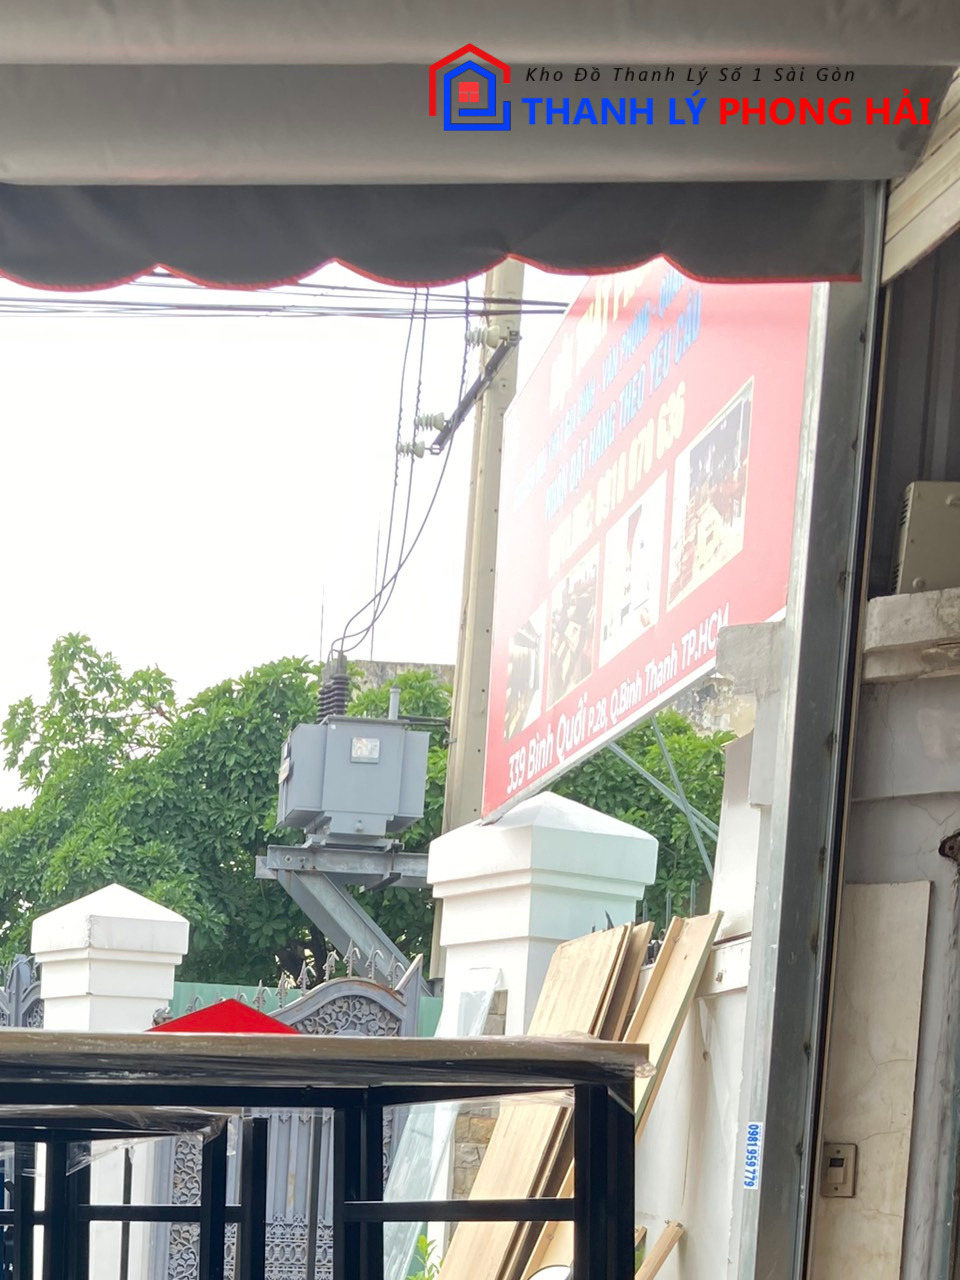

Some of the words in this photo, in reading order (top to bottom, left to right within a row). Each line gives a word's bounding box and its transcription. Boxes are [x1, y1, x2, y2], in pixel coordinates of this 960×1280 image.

[619, 362, 644, 430] THEO
[506, 748, 527, 794] 339
[528, 722, 553, 777] Bình
[747, 1124, 759, 1147] 0981
[745, 1148, 758, 1168] 959
[744, 1169, 756, 1187] 779
